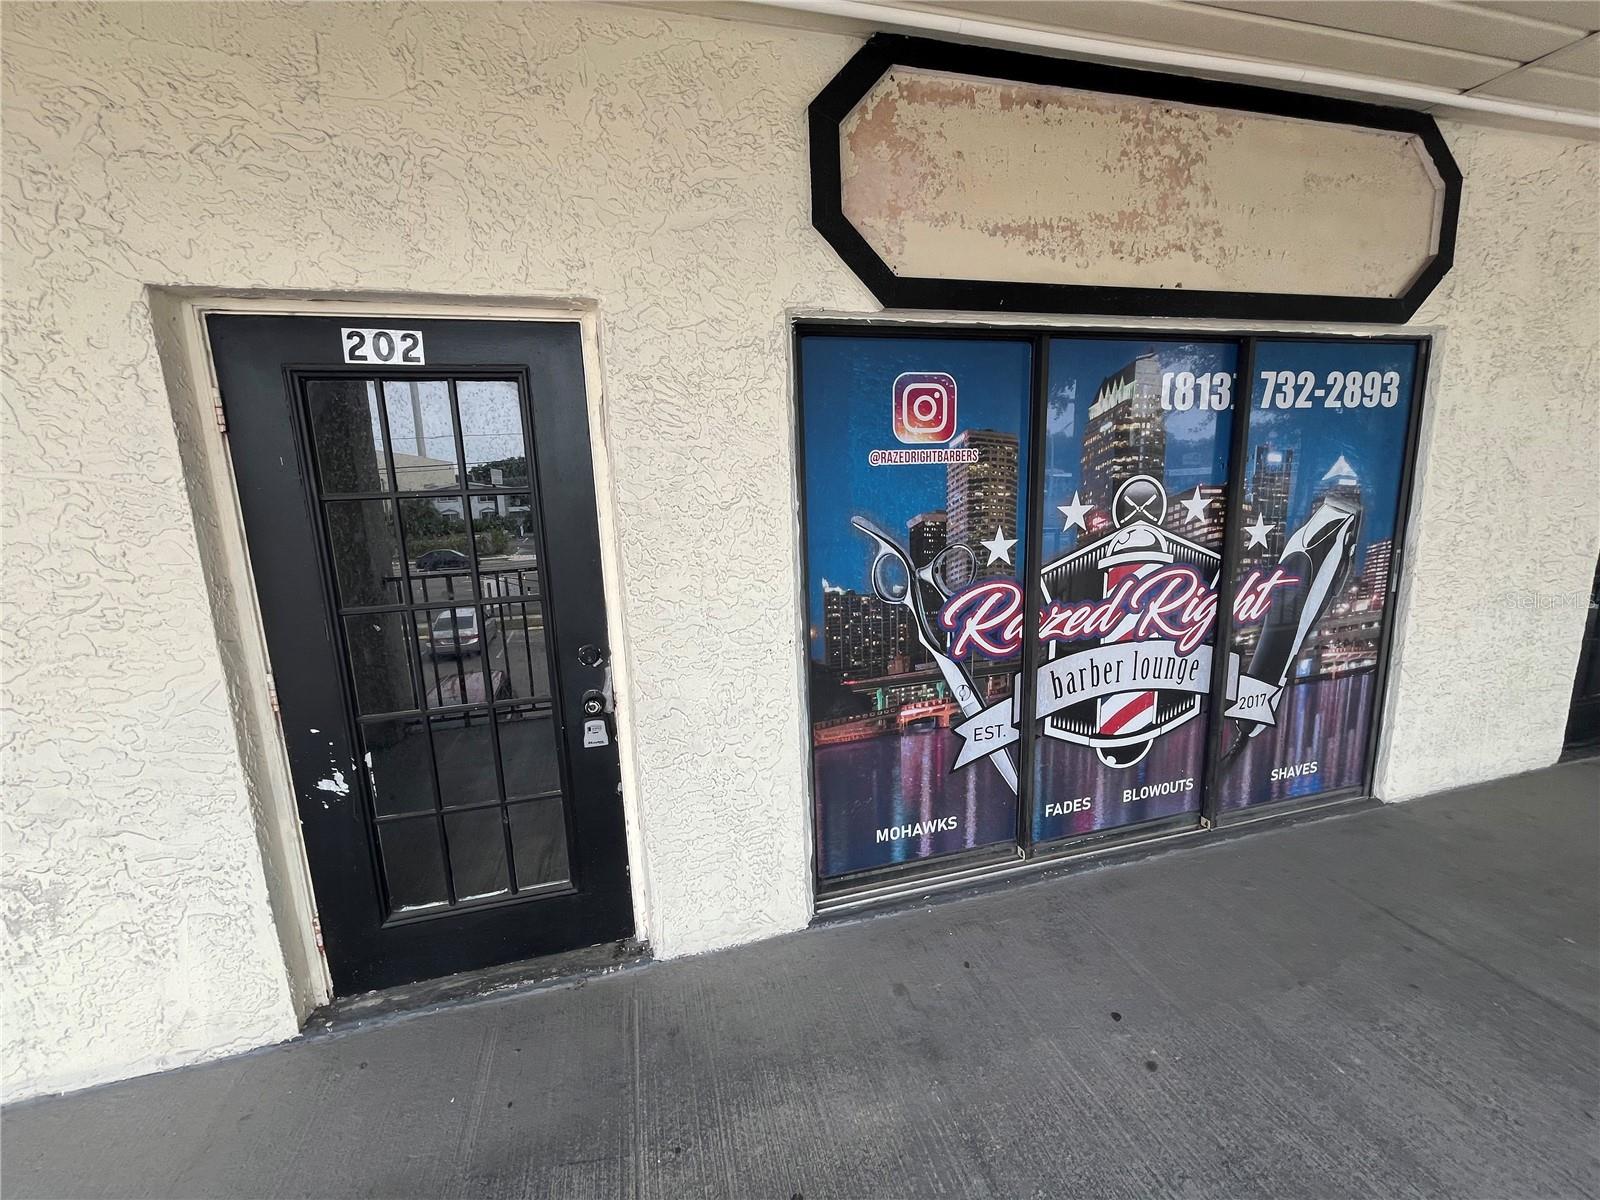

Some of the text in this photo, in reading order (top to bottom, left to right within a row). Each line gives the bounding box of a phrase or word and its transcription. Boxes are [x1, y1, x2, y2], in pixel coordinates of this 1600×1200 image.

[347, 331, 421, 362] 202
[1161, 371, 1400, 411] (813 732-2893
[869, 449, 979, 466] @RAZEDRIGHTBARBERS
[1050, 650, 1199, 699] barber lounge
[1239, 693, 1267, 710] 2017
[974, 723, 1006, 742] EST.
[1270, 761, 1318, 782] SHAVES
[1122, 778, 1194, 803] BLOWOUTS
[1045, 797, 1091, 818] FADES
[875, 815, 958, 843] MOHAWKS
